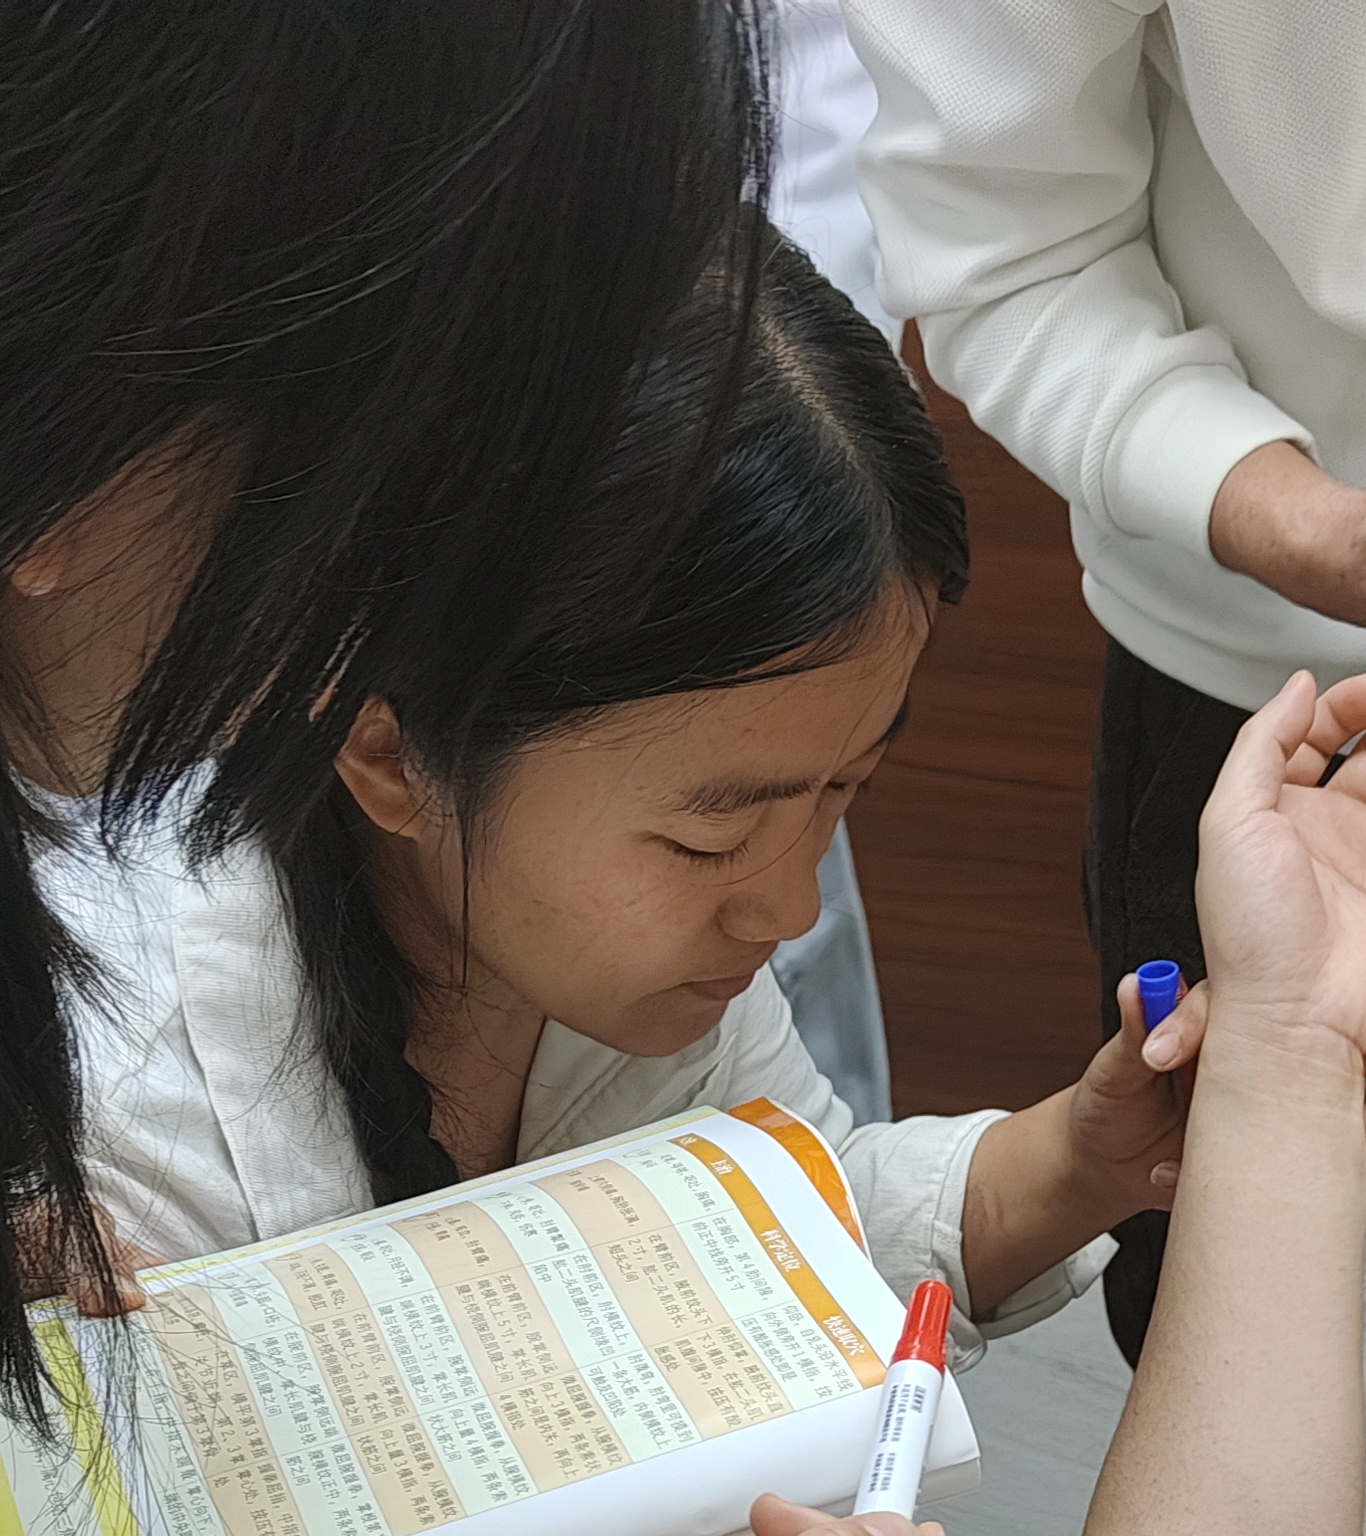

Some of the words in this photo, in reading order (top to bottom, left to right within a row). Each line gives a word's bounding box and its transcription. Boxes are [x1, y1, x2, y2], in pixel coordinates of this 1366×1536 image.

[531, 1262, 553, 1284] 陷中
[605, 1242, 641, 1283] 短头之间
[689, 1220, 747, 1293] 前正中线旁开5寸
[758, 1228, 805, 1272] 科学定位
[821, 1313, 868, 1356] 快速取穴
[585, 1366, 628, 1418] 可触及凹陷处
[355, 1434, 386, 1475] 状筋之间
[425, 1412, 462, 1463] 状大筋之间
[285, 1454, 310, 1487] 筋之间
